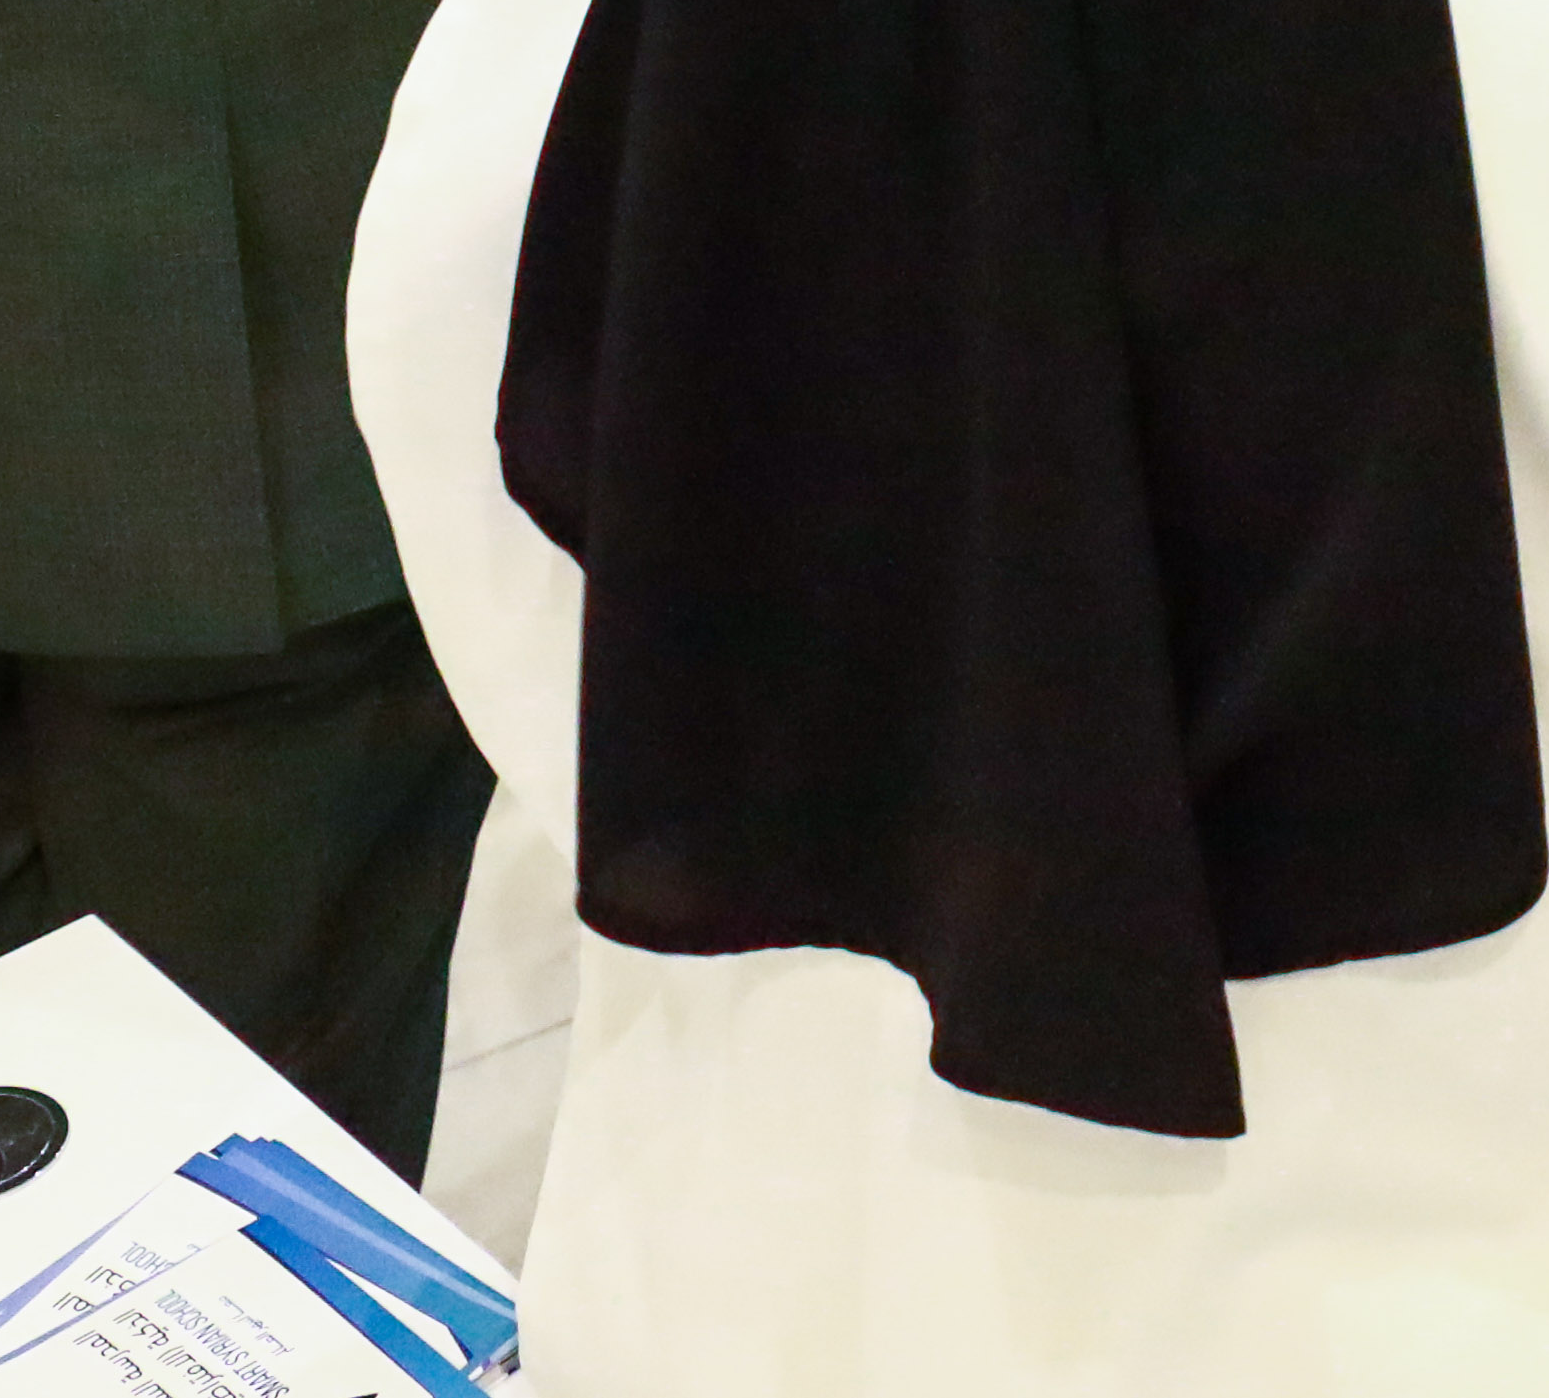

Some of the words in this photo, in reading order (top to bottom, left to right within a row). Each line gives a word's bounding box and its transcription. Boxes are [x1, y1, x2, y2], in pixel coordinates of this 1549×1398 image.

[120, 1241, 176, 1274] HOOL
[154, 1288, 209, 1331] SCHOOL
[73, 1329, 143, 1383] المدرسة
[196, 1323, 250, 1366] SYRIAN
[233, 1360, 290, 1398] SMART
